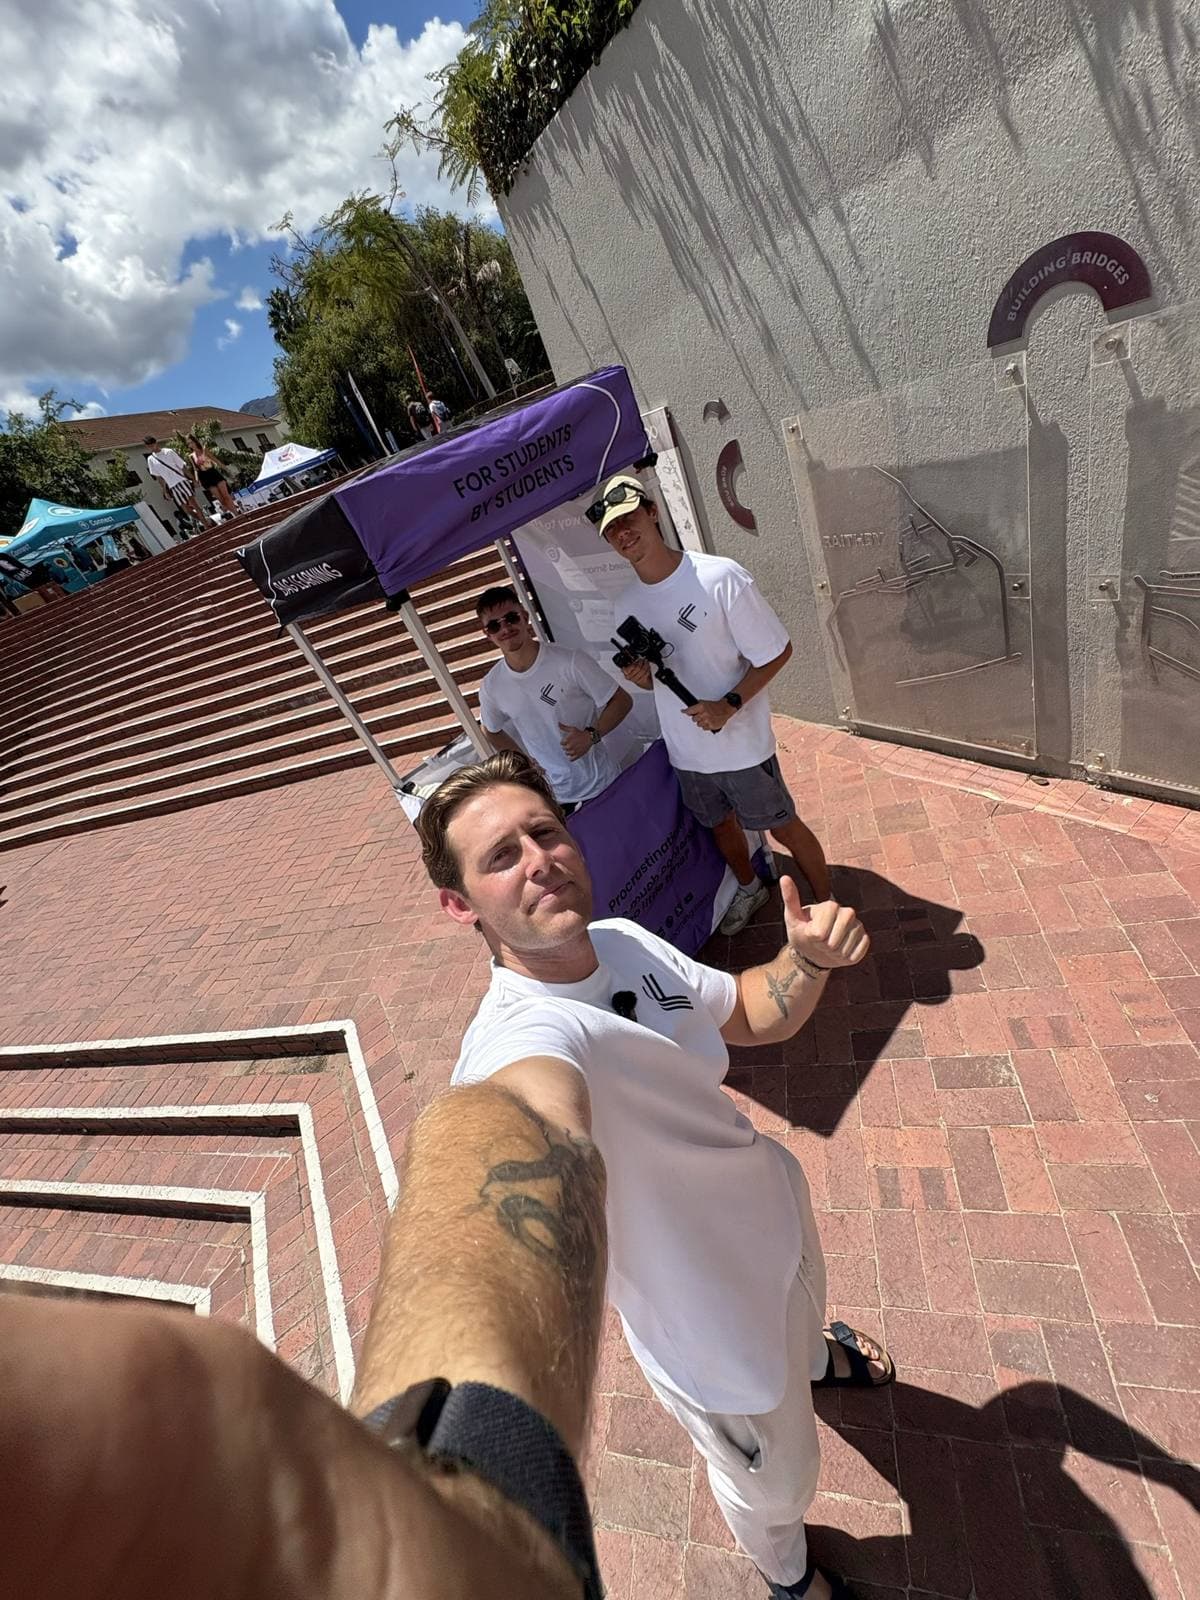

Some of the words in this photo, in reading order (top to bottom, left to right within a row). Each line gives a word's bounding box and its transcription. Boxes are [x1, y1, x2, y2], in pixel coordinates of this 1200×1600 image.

[1006, 255, 1068, 323] BUILDING
[1071, 251, 1131, 286] BRIDGES
[452, 465, 497, 499] FOR
[494, 424, 572, 478] STUDENTS
[470, 496, 493, 522] BY
[495, 455, 575, 509] STUDENTS
